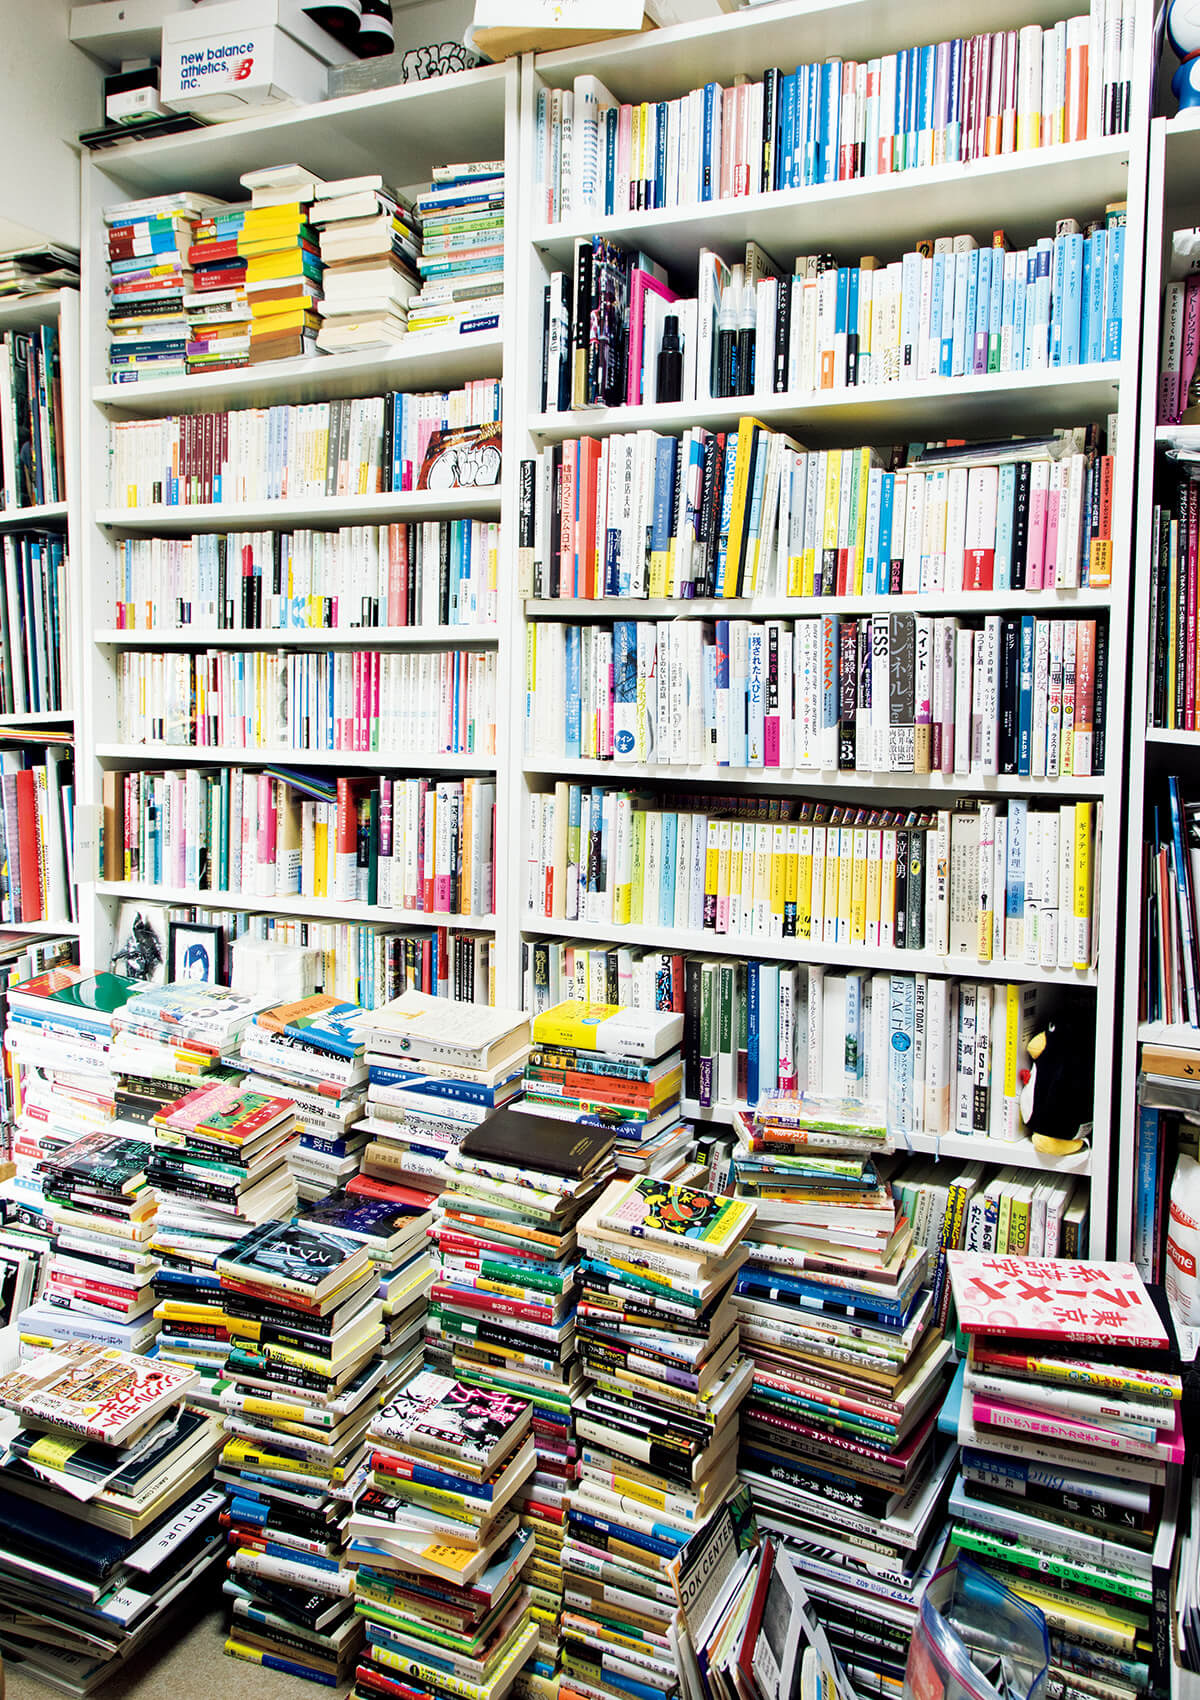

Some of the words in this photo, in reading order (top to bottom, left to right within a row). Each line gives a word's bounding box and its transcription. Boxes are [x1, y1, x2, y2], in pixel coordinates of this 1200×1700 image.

[180, 52, 204, 66] new
[206, 41, 254, 62] balance
[180, 75, 201, 90] inc.
[181, 60, 230, 80] athletics,
[873, 617, 889, 658] LESS
[889, 615, 907, 697] トンネル
[845, 638, 858, 721] 木曜殺人クラブ
[896, 840, 906, 879] 泣く男
[916, 984, 925, 1008] HERE
[915, 1009, 925, 1035] TODAY
[963, 995, 975, 1077] 新写真論
[1016, 1215, 1026, 1250] FOOD
[968, 1276, 1142, 1309] ラーメン
[1052, 1306, 1128, 1328] 東京
[1028, 1471, 1064, 1490] Blue
[158, 1493, 218, 1548] NATURE
[876, 1570, 904, 1586] WIP
